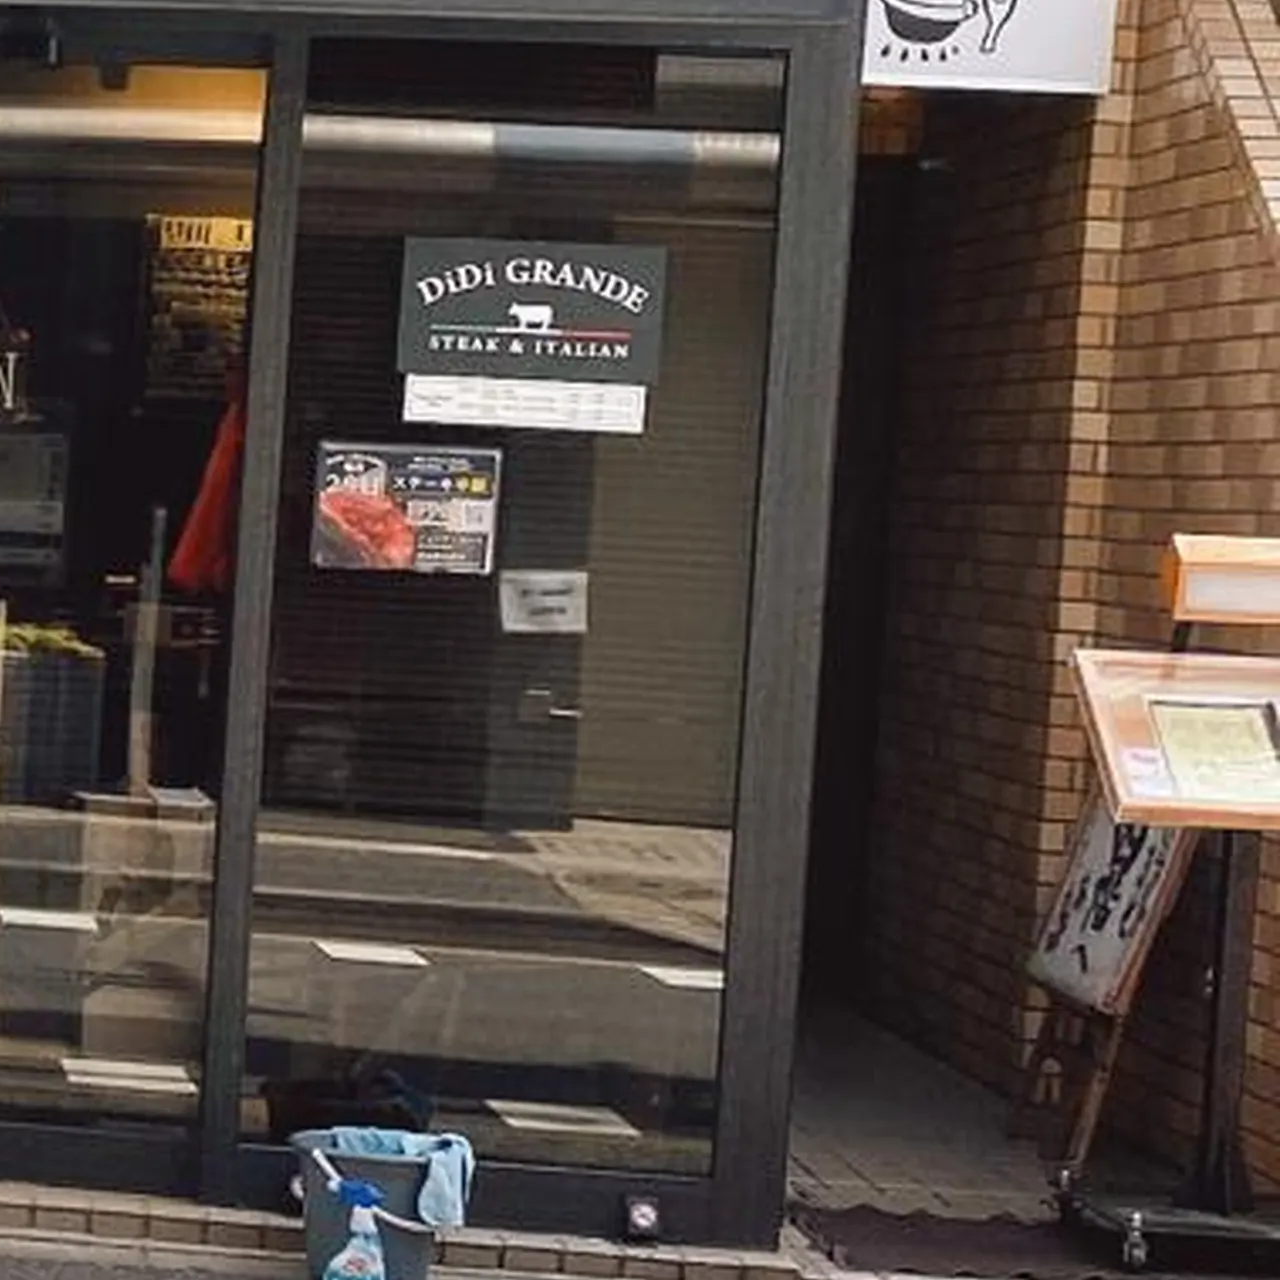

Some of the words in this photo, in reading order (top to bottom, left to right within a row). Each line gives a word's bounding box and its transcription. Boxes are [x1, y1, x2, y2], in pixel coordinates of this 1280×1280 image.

[416, 261, 496, 306] DiDi
[505, 257, 651, 315] GRANDE
[428, 334, 500, 352] STEAK
[508, 337, 523, 354] &
[535, 338, 630, 359] ITALIAN
